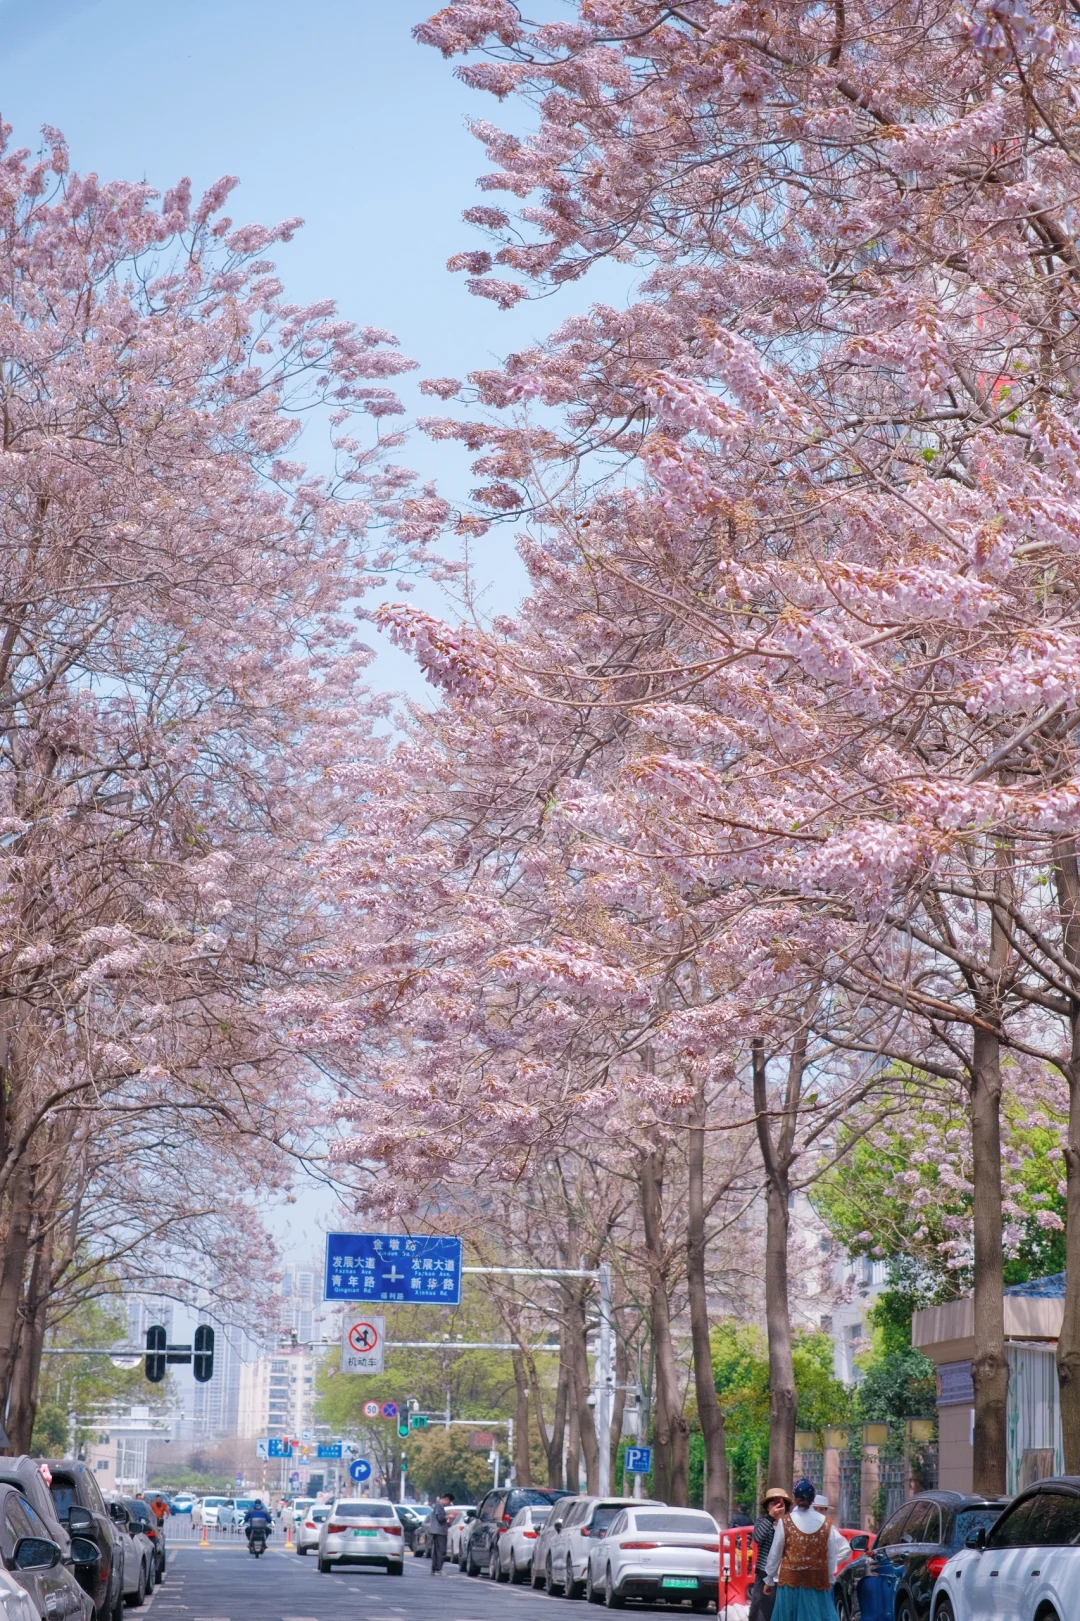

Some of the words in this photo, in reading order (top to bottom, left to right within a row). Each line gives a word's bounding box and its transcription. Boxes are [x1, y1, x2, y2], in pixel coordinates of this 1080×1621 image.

[372, 1238, 416, 1252] 金墩路
[332, 1256, 376, 1269] 发展大道
[411, 1258, 455, 1272] 发展大道
[332, 1274, 376, 1288] 青年路
[410, 1278, 454, 1290] 新华路
[348, 1357, 377, 1367] 机动车
[366, 1405, 376, 1414] 50
[627, 1450, 641, 1469] P
